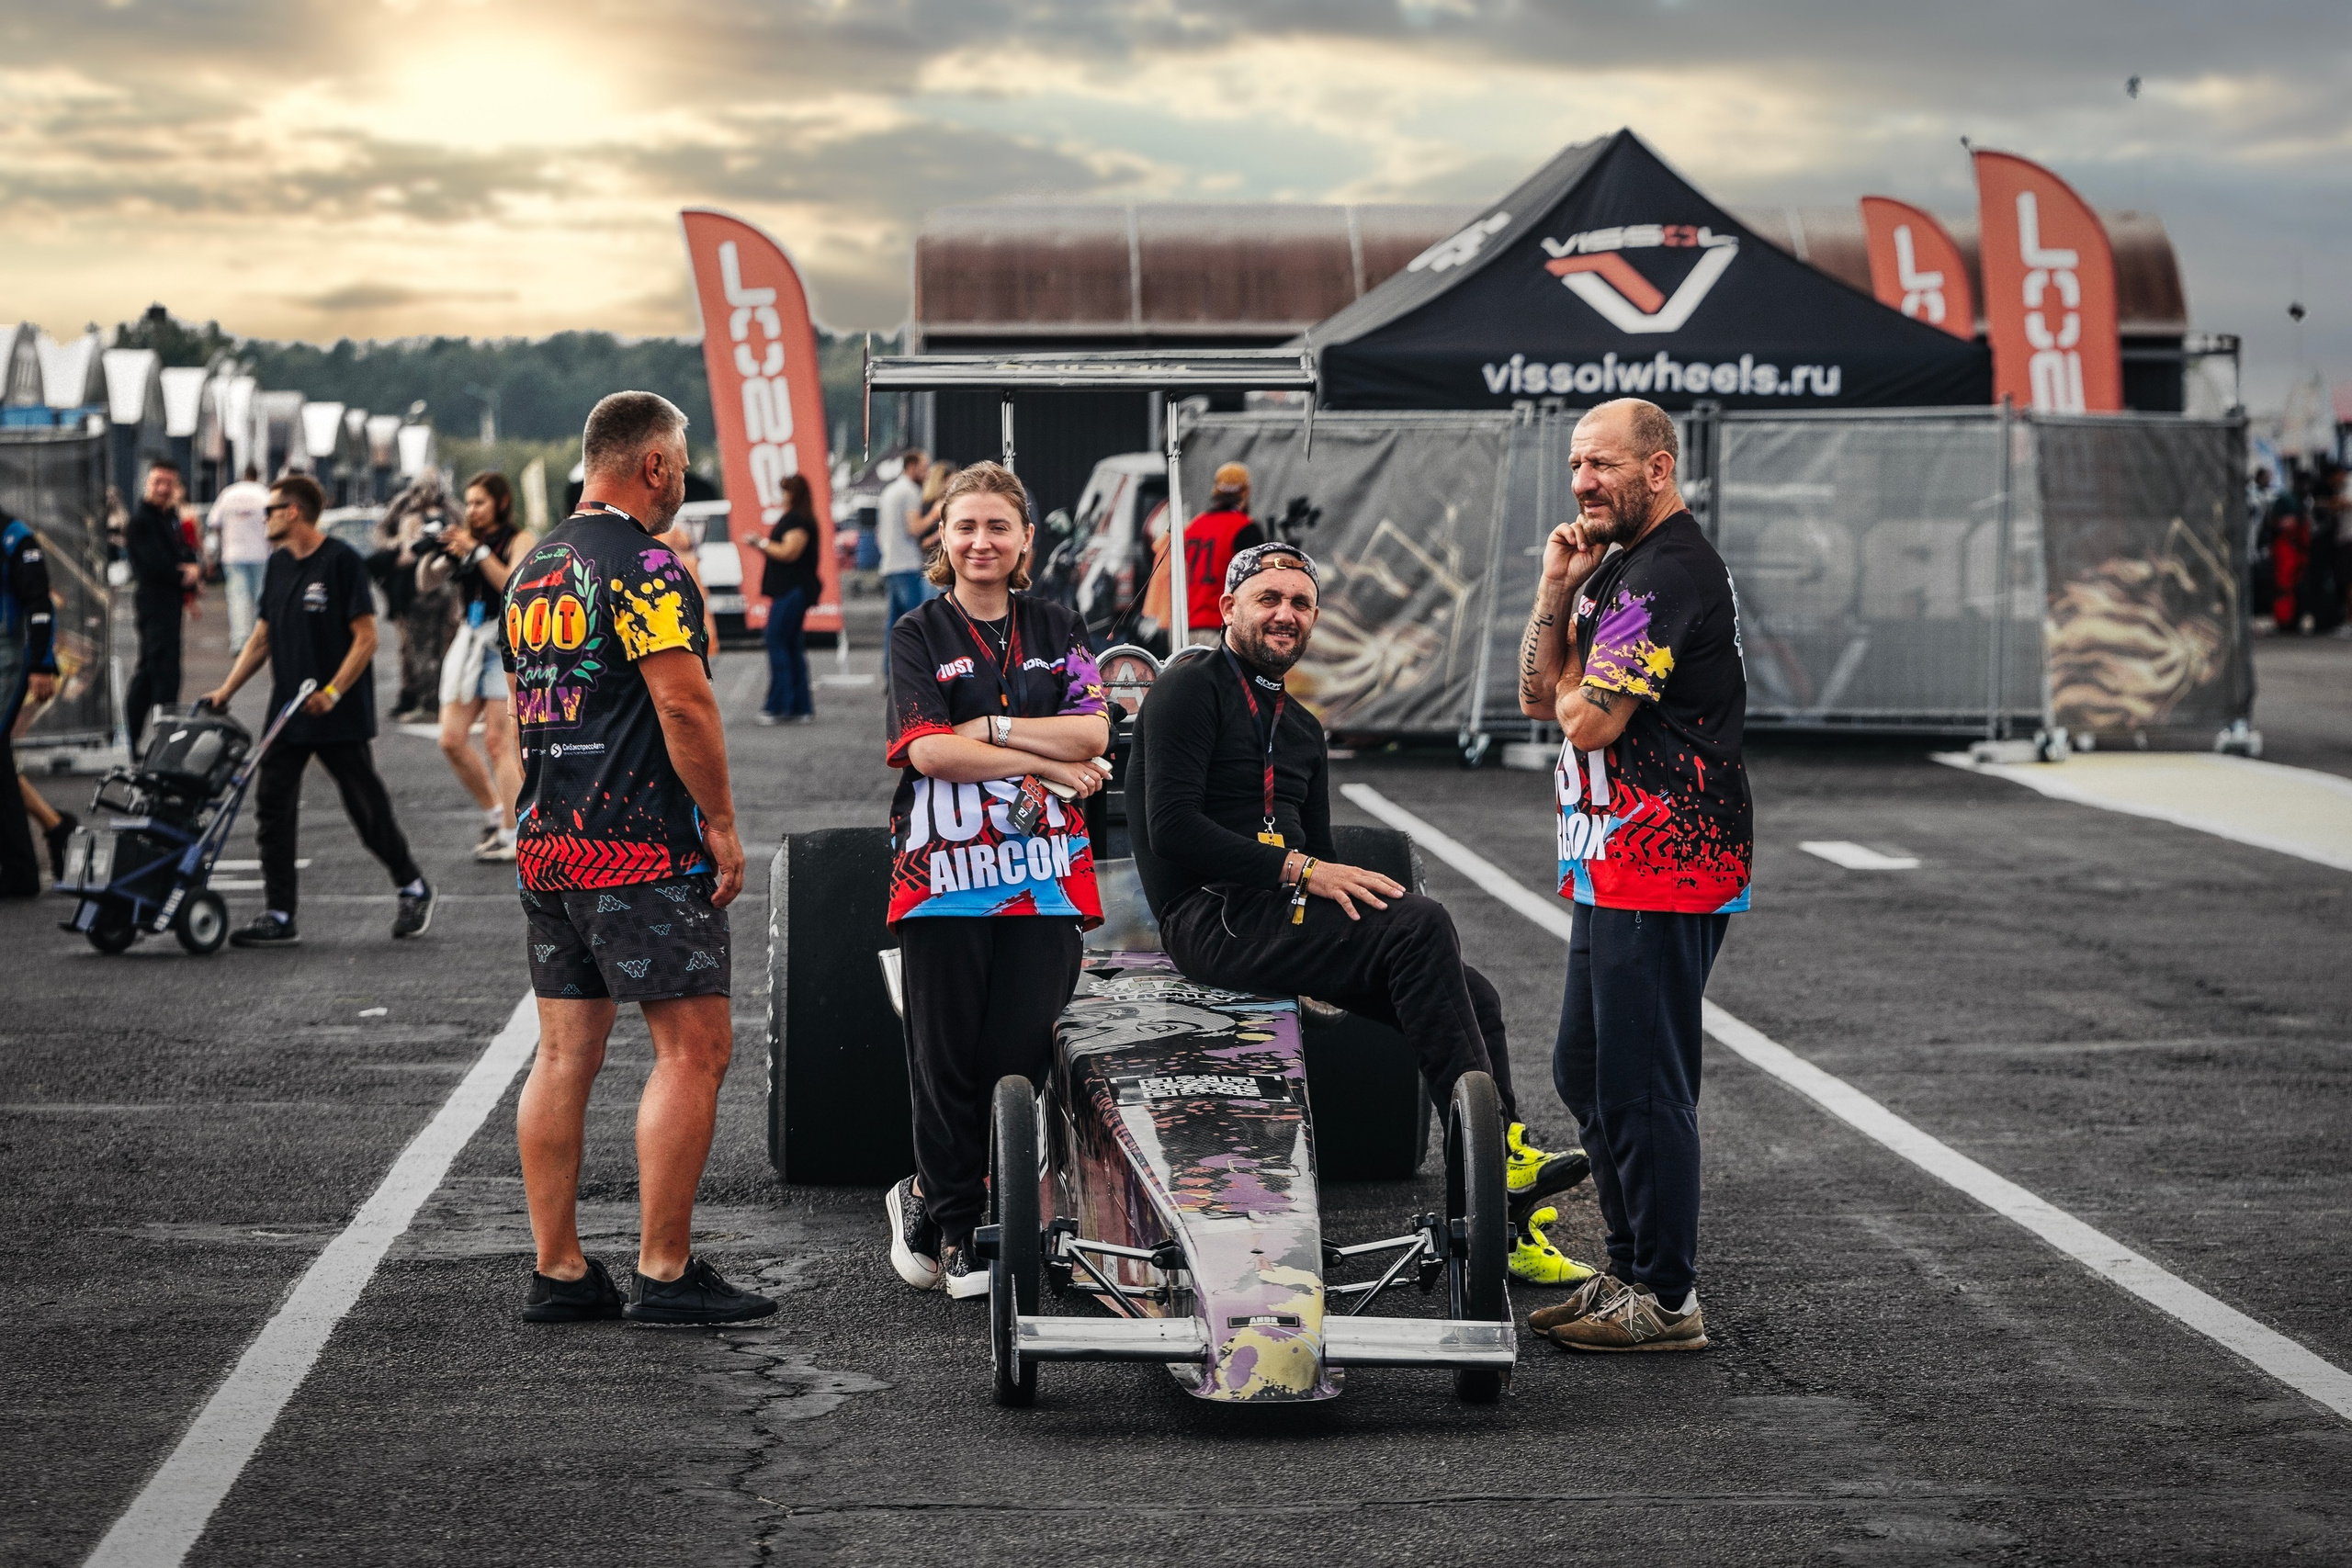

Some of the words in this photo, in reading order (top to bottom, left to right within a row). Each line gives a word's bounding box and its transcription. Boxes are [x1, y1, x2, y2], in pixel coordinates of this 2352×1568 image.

[1482, 352, 1841, 396] vissolwheels.ru
[939, 658, 974, 679] JUST
[930, 833, 1071, 895] AIRCON
